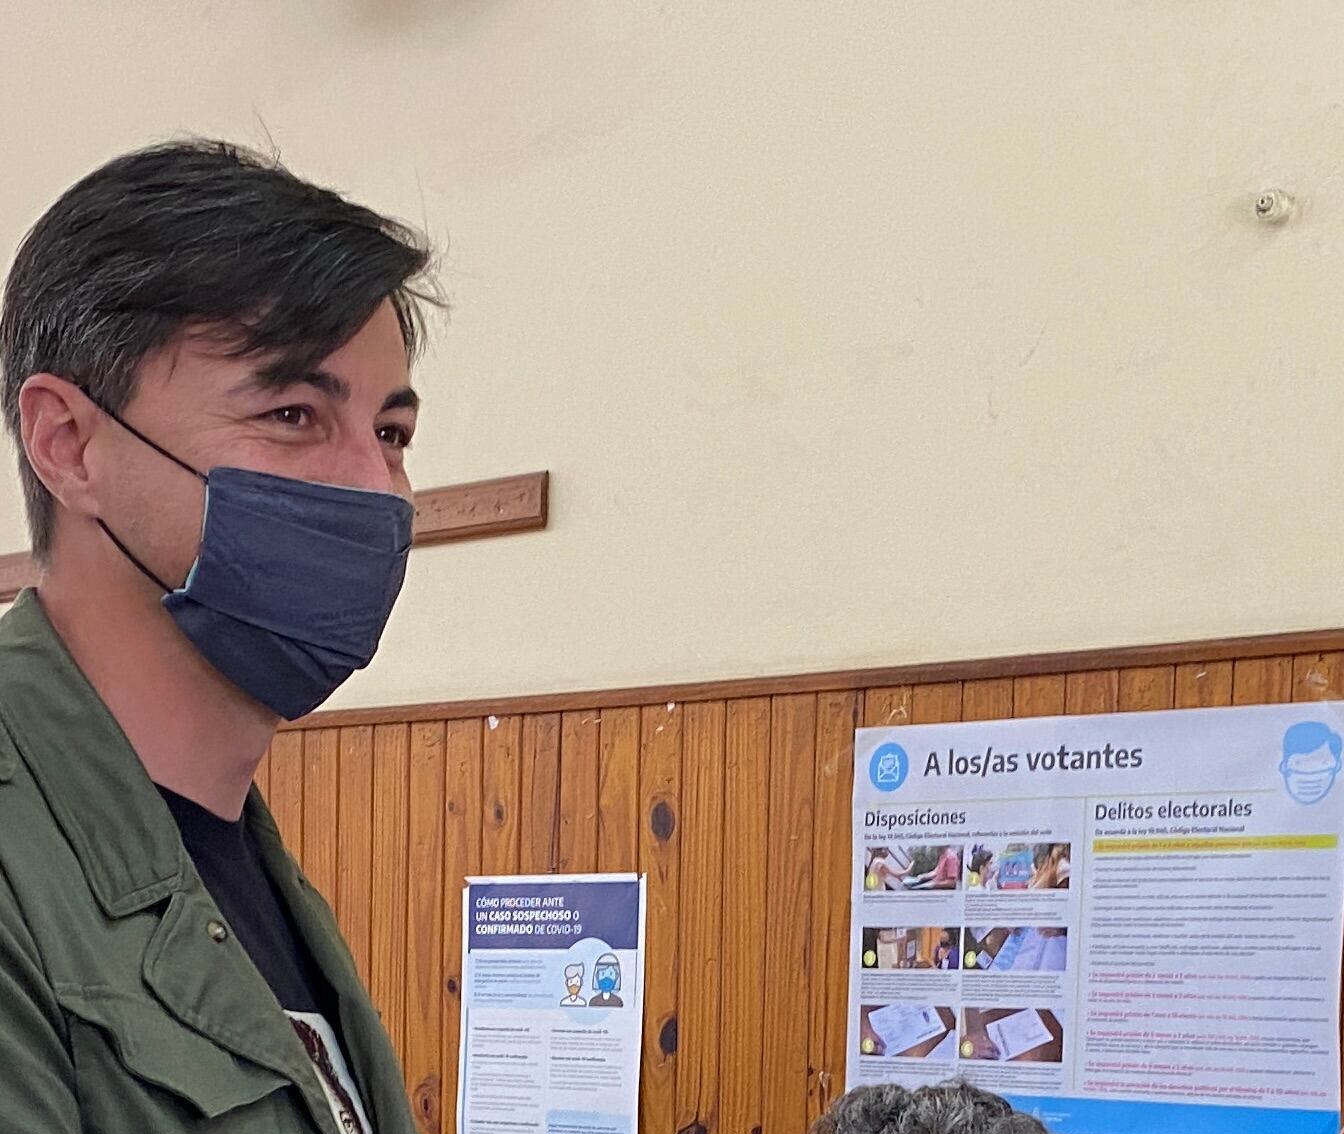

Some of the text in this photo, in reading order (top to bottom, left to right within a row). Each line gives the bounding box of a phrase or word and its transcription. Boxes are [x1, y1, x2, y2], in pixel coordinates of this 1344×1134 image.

[923, 743, 1144, 778] A los/as votantes
[1094, 798, 1253, 821] Delitos electorales
[864, 808, 967, 831] Disposiciones
[476, 896, 564, 908] CÓMO PROCEDER ANTE
[476, 911, 488, 921] UN
[489, 910, 511, 921] CASO
[512, 910, 571, 921] SOSPECHOSO
[476, 924, 582, 935] CONFIRMADO DE COVID-19
